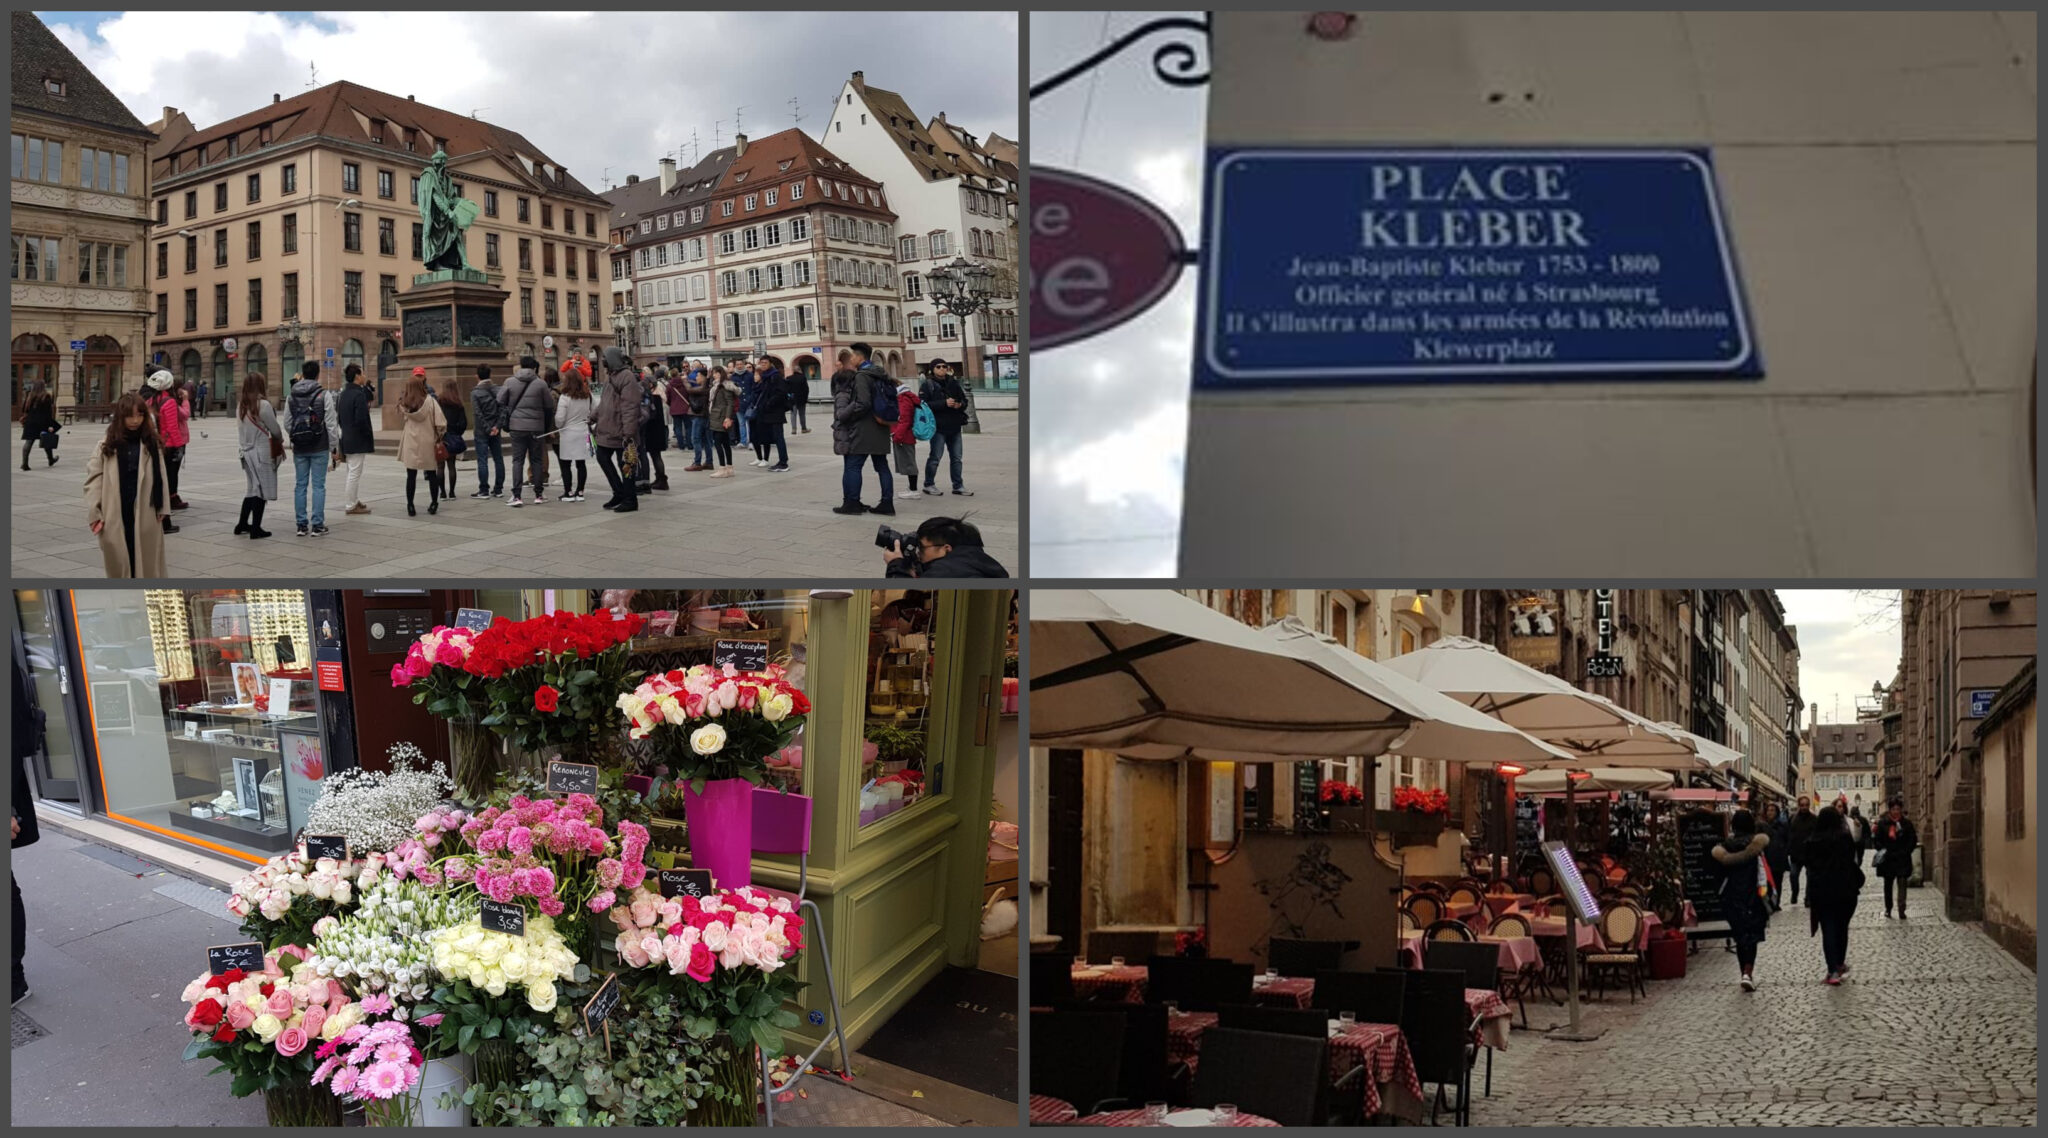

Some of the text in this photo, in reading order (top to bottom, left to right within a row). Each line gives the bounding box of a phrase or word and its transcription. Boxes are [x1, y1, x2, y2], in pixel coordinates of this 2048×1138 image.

[1371, 165, 1570, 201] PLACE
[1361, 210, 1589, 247] KLEBER
[1288, 256, 1442, 280] Jean-Baptiste
[1538, 255, 1587, 274] 1753
[1609, 254, 1660, 274] 1800
[1295, 283, 1385, 305] Officier
[1481, 282, 1507, 303] né
[1516, 281, 1528, 302] à
[1533, 282, 1660, 306] Strasbourg
[1226, 313, 1244, 333] Il
[1361, 311, 1416, 331] dans
[1422, 311, 1455, 330] les
[1460, 309, 1541, 330] armées
[1546, 309, 1575, 329] de
[1579, 309, 1601, 329] la
[1607, 308, 1729, 329] Révolution
[1414, 338, 1555, 361] Klewerplatz
[717, 641, 733, 649] Rose
[662, 871, 688, 882] Rose
[483, 900, 500, 912] Rose
[225, 947, 253, 958] Rose
